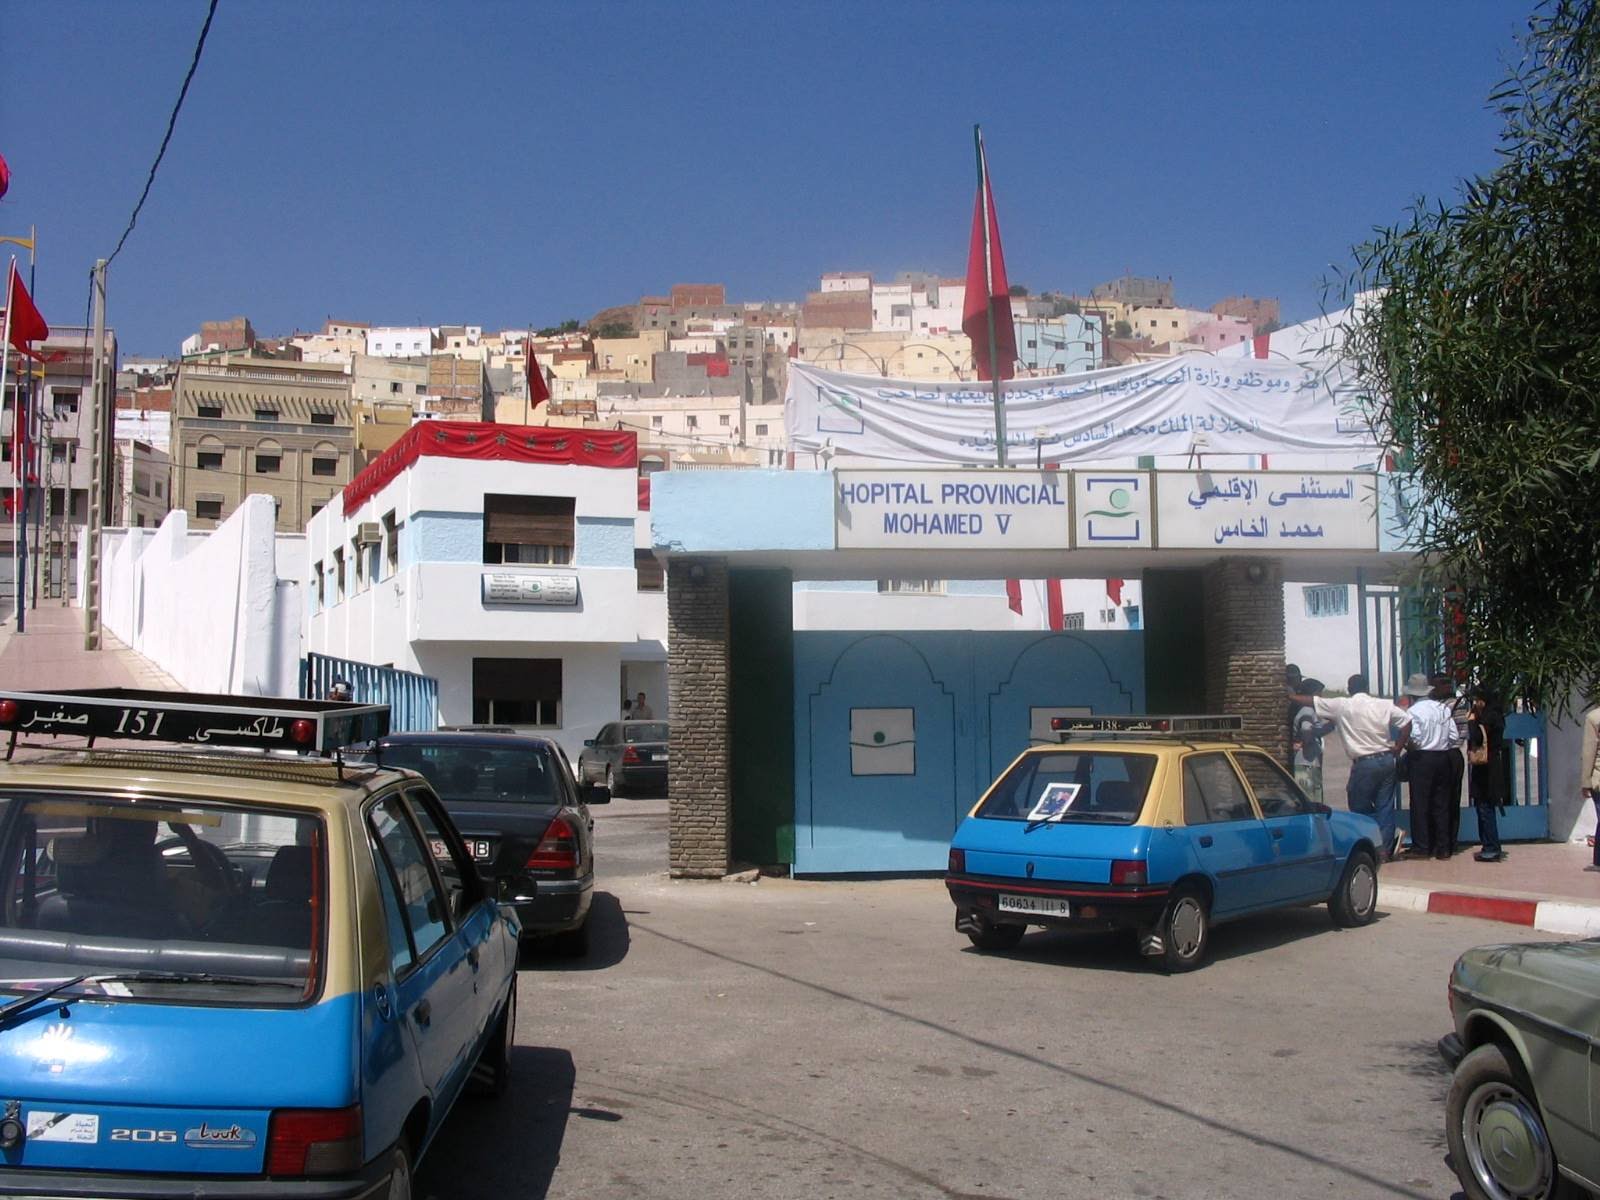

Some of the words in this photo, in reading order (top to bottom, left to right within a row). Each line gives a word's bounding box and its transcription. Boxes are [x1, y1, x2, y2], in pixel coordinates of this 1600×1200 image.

[841, 483, 933, 505] HOPITAL
[941, 483, 1065, 506] PROVINCIAL
[1187, 475, 1258, 510] الإقليمي
[1267, 476, 1354, 507] المستشفى
[883, 513, 983, 535] MOHAMED
[995, 513, 1013, 535] V
[1213, 515, 1268, 544] الخامس
[1279, 520, 1324, 538] محمد
[21, 704, 89, 728] صغير
[113, 709, 166, 736] 151
[187, 715, 285, 742] طاكسي
[111, 1129, 177, 1142] 205
